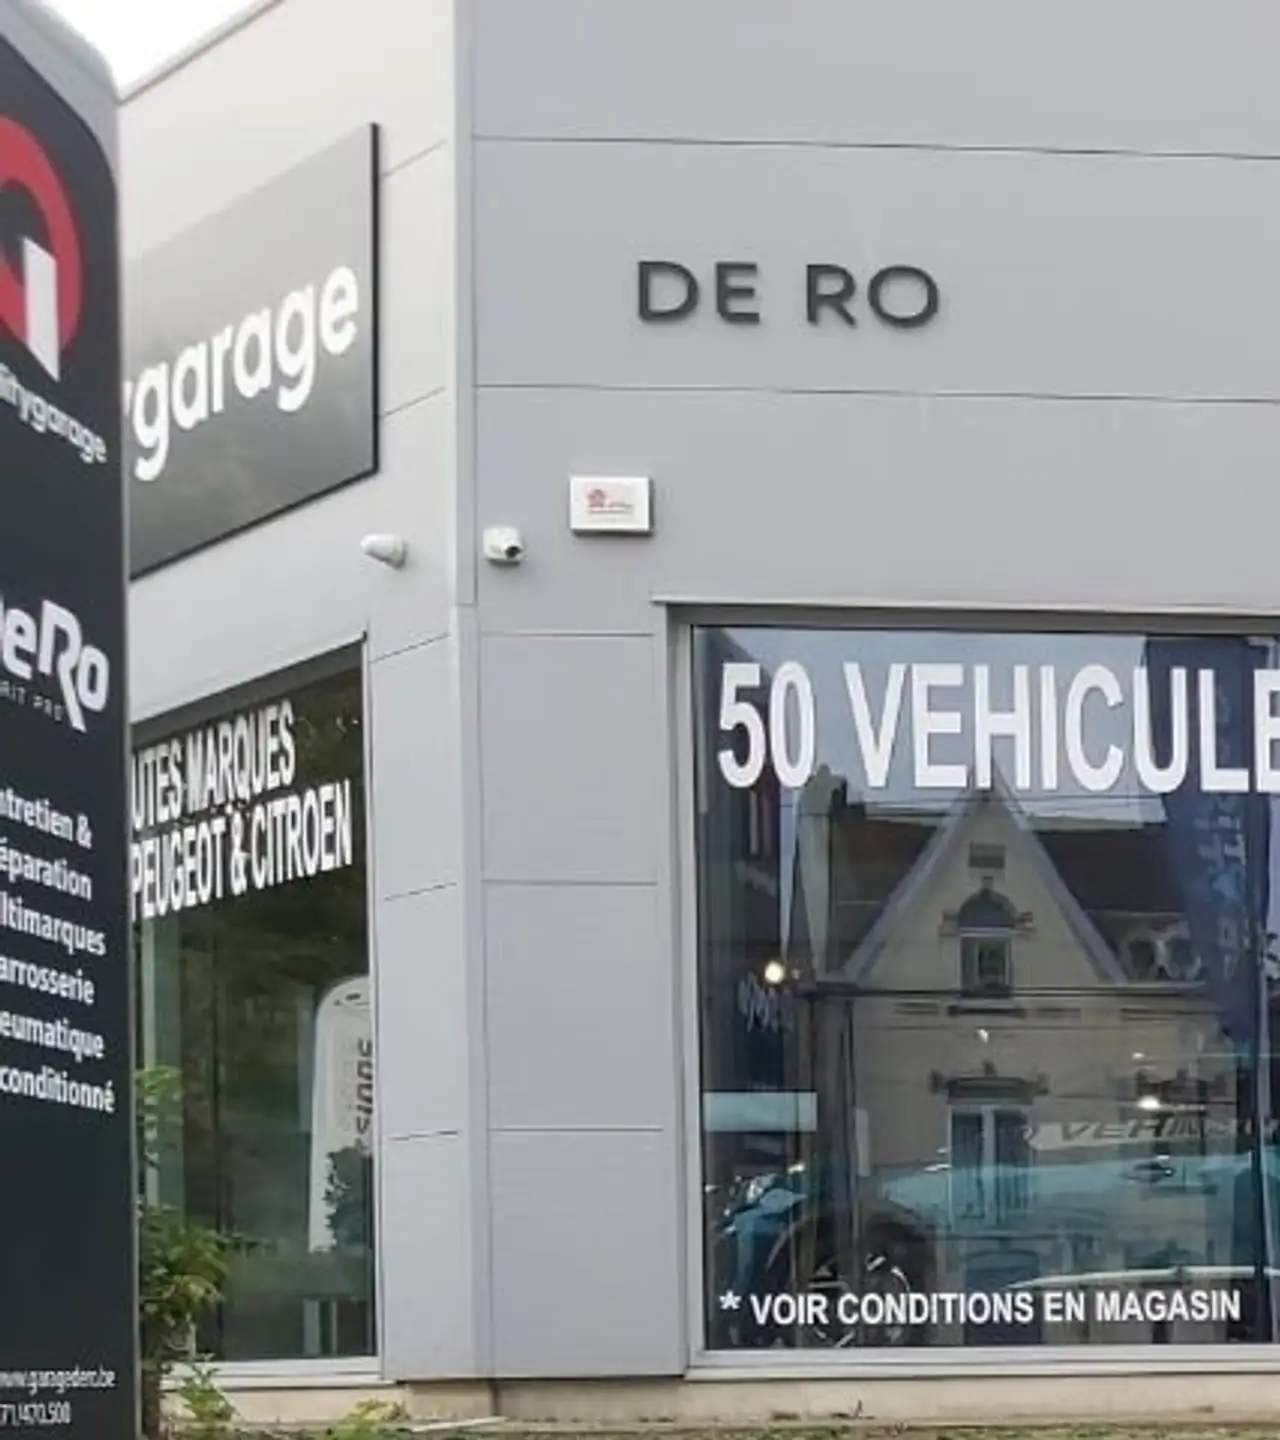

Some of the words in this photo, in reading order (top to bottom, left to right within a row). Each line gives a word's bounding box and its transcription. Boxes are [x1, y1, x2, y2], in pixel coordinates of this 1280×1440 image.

[637, 260, 760, 323] DE
[805, 263, 940, 328] RO
[123, 266, 358, 482] garage
[186, 700, 296, 814] MARQUES
[717, 661, 815, 788] 50
[77, 813, 92, 850] &
[131, 816, 226, 923] PEUGEOT
[230, 810, 251, 896] &
[252, 777, 352, 891] CITROEN
[752, 1293, 828, 1326] VOIR
[837, 1291, 1034, 1325] CONDITIONS
[1044, 1291, 1085, 1322] EN
[1096, 1289, 1241, 1322] MAGASIN
